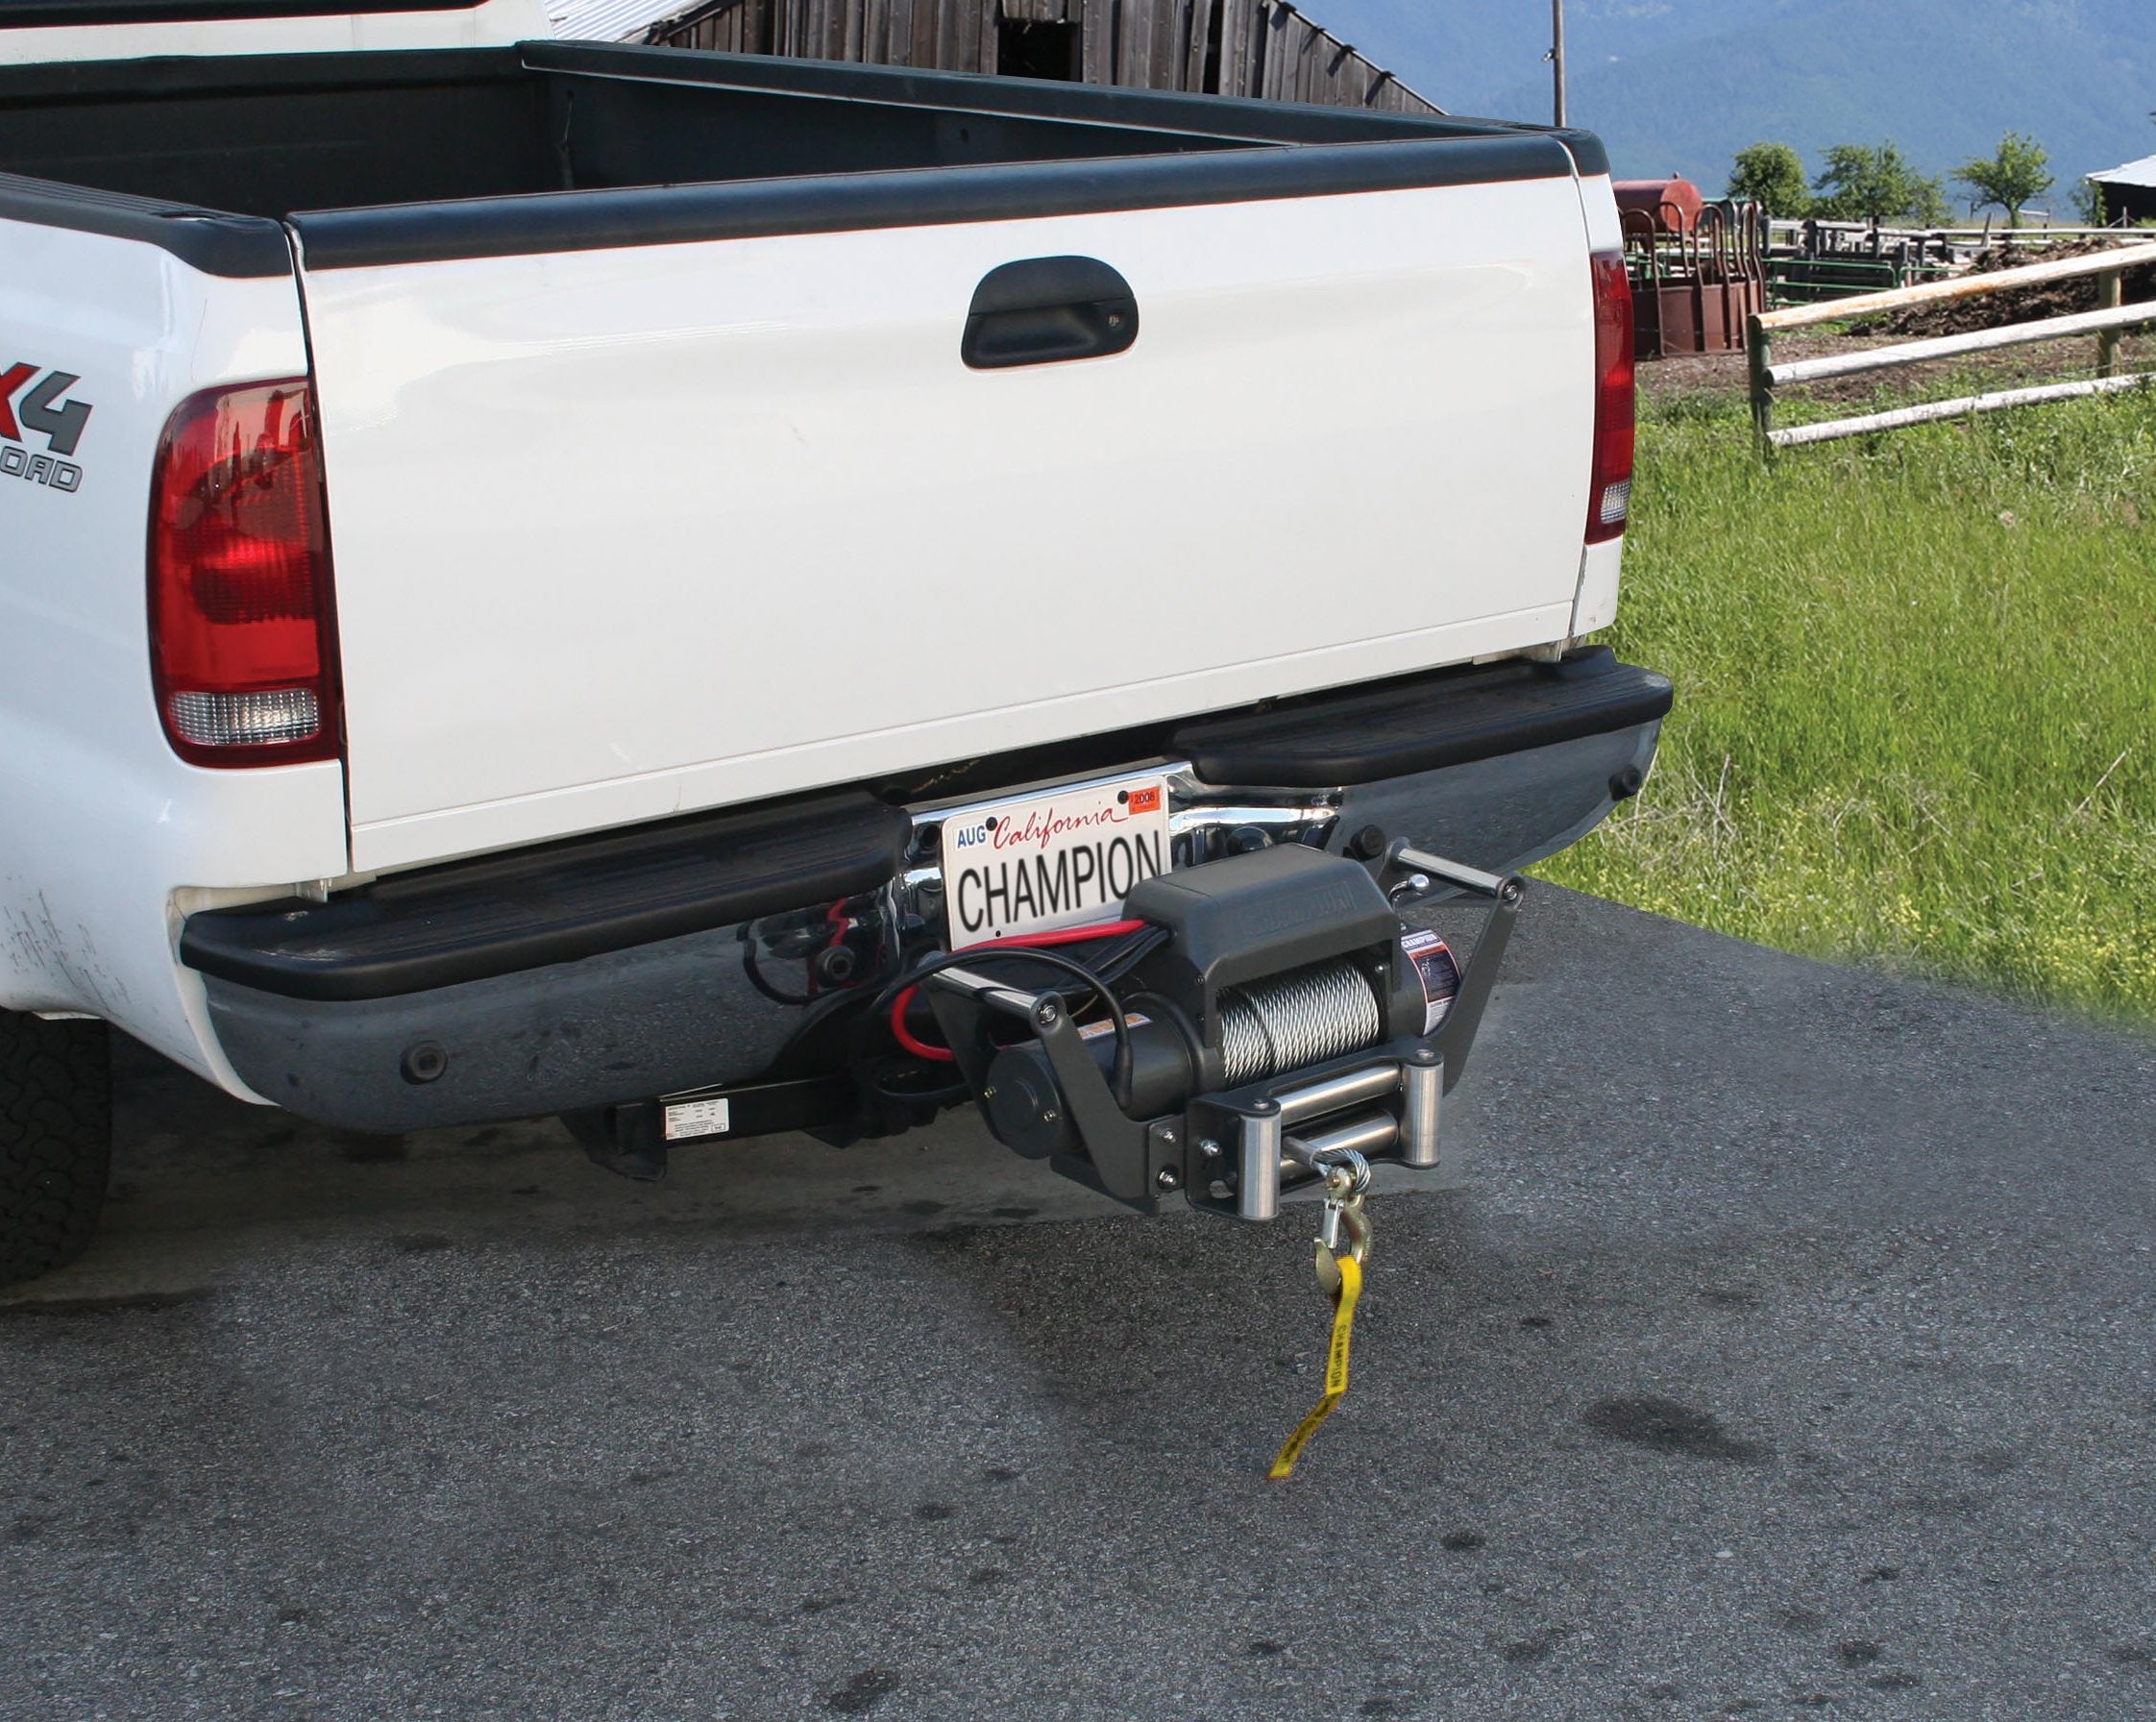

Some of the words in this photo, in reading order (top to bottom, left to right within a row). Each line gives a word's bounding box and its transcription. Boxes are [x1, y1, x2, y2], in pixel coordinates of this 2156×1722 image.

[958, 826, 986, 848] AUG
[993, 800, 1128, 849] California
[958, 829, 1162, 933] CHAMPION
